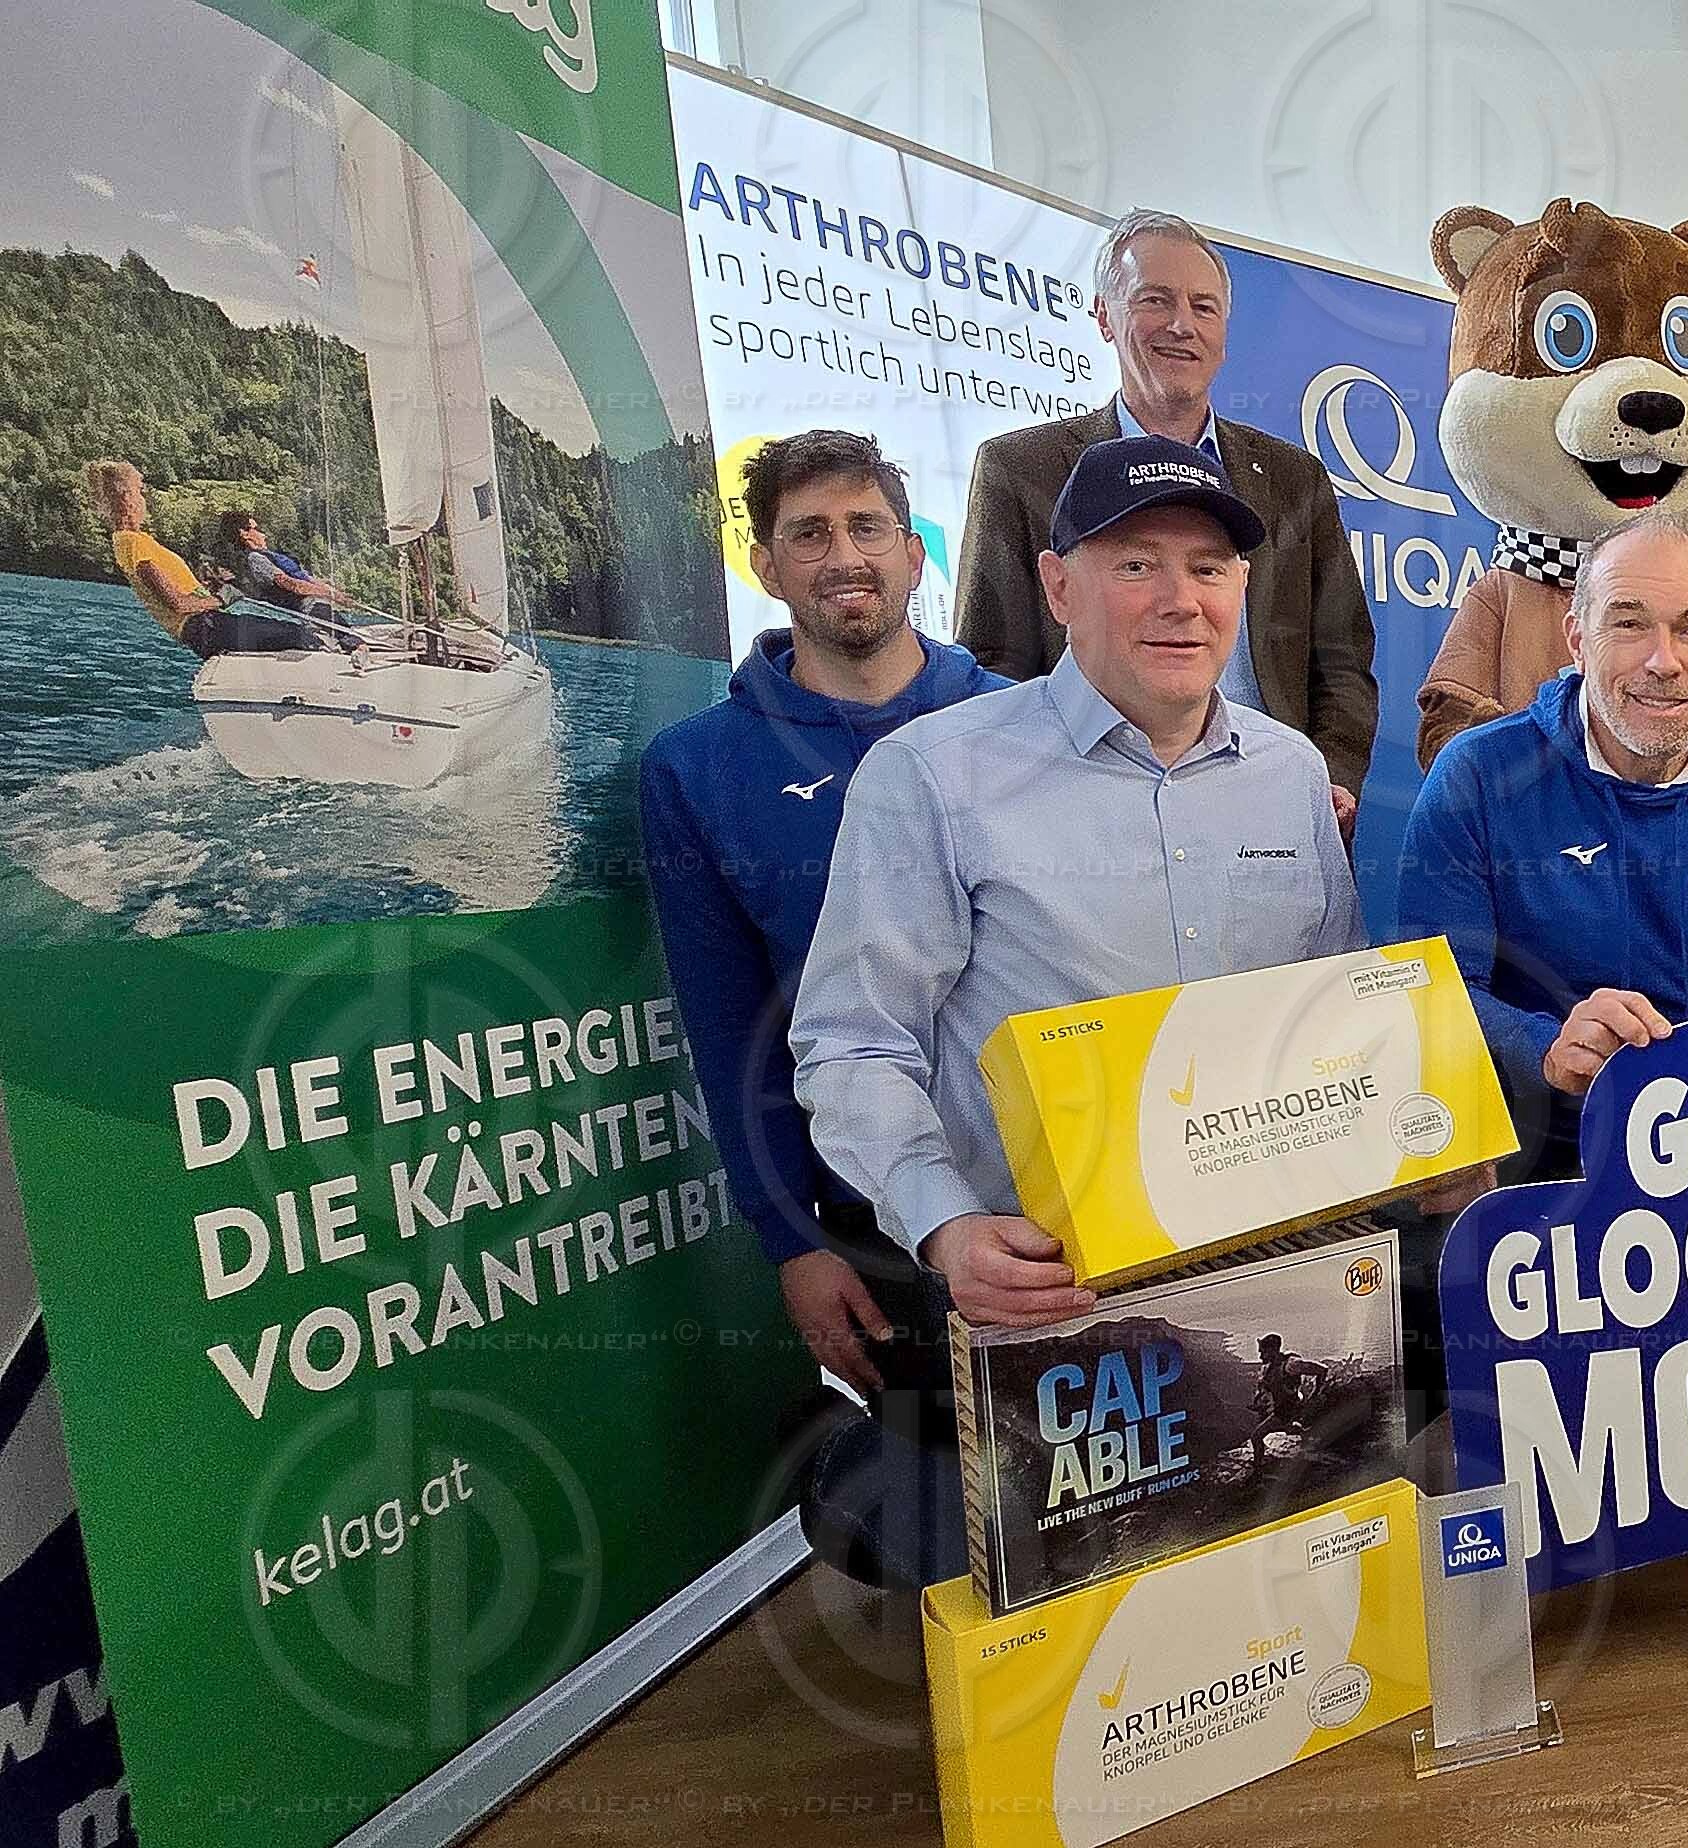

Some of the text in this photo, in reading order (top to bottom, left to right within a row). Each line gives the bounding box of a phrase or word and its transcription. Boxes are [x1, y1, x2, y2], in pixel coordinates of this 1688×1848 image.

[698, 233, 1093, 384] In jeder Lebenslage
[709, 313, 905, 387] sportlich
[1128, 462, 1222, 489] ARTHROBENE
[1040, 1020, 1104, 1042] 15 STICKS
[1311, 1049, 1369, 1077] Sport
[172, 1056, 349, 1171] DIE
[1184, 1075, 1379, 1145] ARTHROBENE
[1188, 1105, 1365, 1161] DER MAGNESIUMSTICK FÜR
[1193, 1152, 1258, 1177] KNORPEL
[1263, 1143, 1290, 1159] UND
[194, 1083, 711, 1300] DIE KÄRNTEN
[207, 1167, 731, 1419] VORANTREIBT
[1036, 1341, 1185, 1444] CAP
[1046, 1410, 1190, 1509] ABLE
[1037, 1512, 1063, 1531] LIVE
[1064, 1506, 1087, 1524] THE
[1087, 1498, 1115, 1516] NEW
[1147, 1479, 1171, 1496] RUN
[1171, 1469, 1201, 1488] CAPS
[255, 1457, 475, 1606] kelag.at
[1311, 1540, 1330, 1553] mit
[1330, 1526, 1370, 1546] Vitamin
[1312, 1551, 1330, 1565] mit
[1447, 1546, 1502, 1567] UNIQA
[981, 1627, 1047, 1659] 15 STICKS
[1246, 1626, 1303, 1660] Sport
[1101, 1648, 1307, 1750] ARTHROBENE
[1102, 1684, 1286, 1767] DER MAGNESIUMSTICK FÜR
[1103, 1749, 1171, 1783] KNORPEL
[1173, 1734, 1205, 1755] UND
